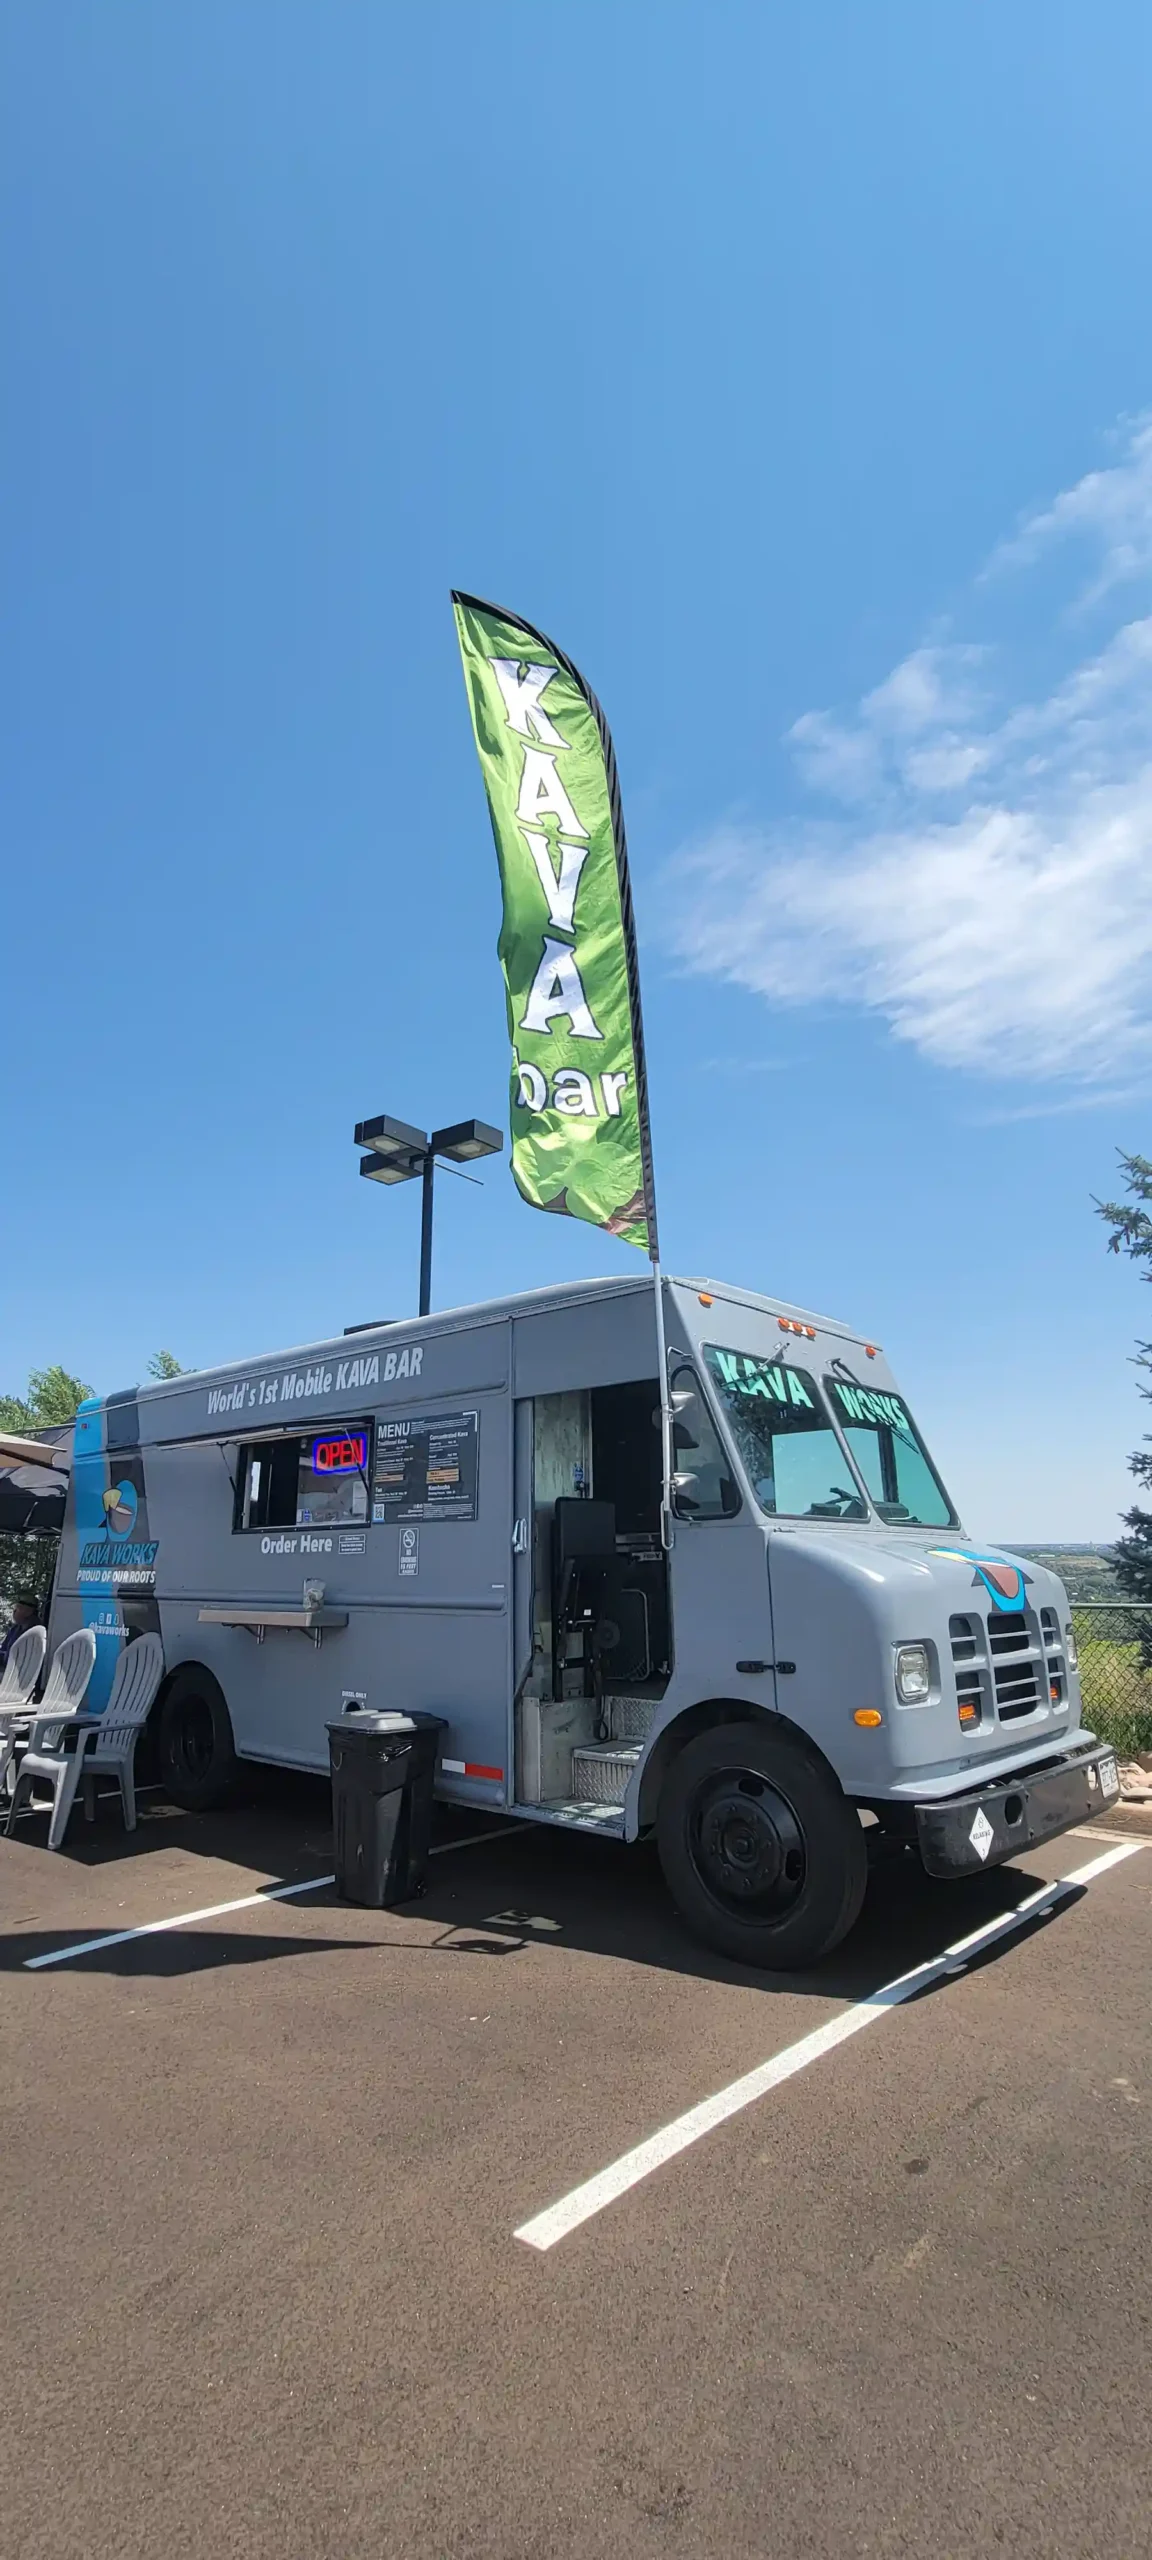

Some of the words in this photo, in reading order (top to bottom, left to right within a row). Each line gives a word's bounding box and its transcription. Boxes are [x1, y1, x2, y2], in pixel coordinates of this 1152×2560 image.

[487, 655, 605, 1039] KAVA
[513, 1046, 628, 1118] bar
[207, 1382, 256, 1415] World's
[258, 1380, 277, 1406] 1st
[280, 1366, 332, 1402] Mobile
[335, 1356, 379, 1391] KAVA
[383, 1347, 424, 1382] BAR
[715, 1351, 815, 1409] KAVA
[834, 1383, 910, 1431] WORKS
[378, 1422, 410, 1439] MENU
[318, 1439, 364, 1471] OPEN
[82, 1543, 110, 1566] KAVA
[111, 1542, 158, 1565] WORKS
[261, 1535, 297, 1554] Order
[300, 1535, 333, 1553] Here
[77, 1570, 101, 1583] PROUD
[101, 1570, 112, 1583] OF
[112, 1571, 129, 1583] OUR
[130, 1571, 156, 1584] ROOTS
